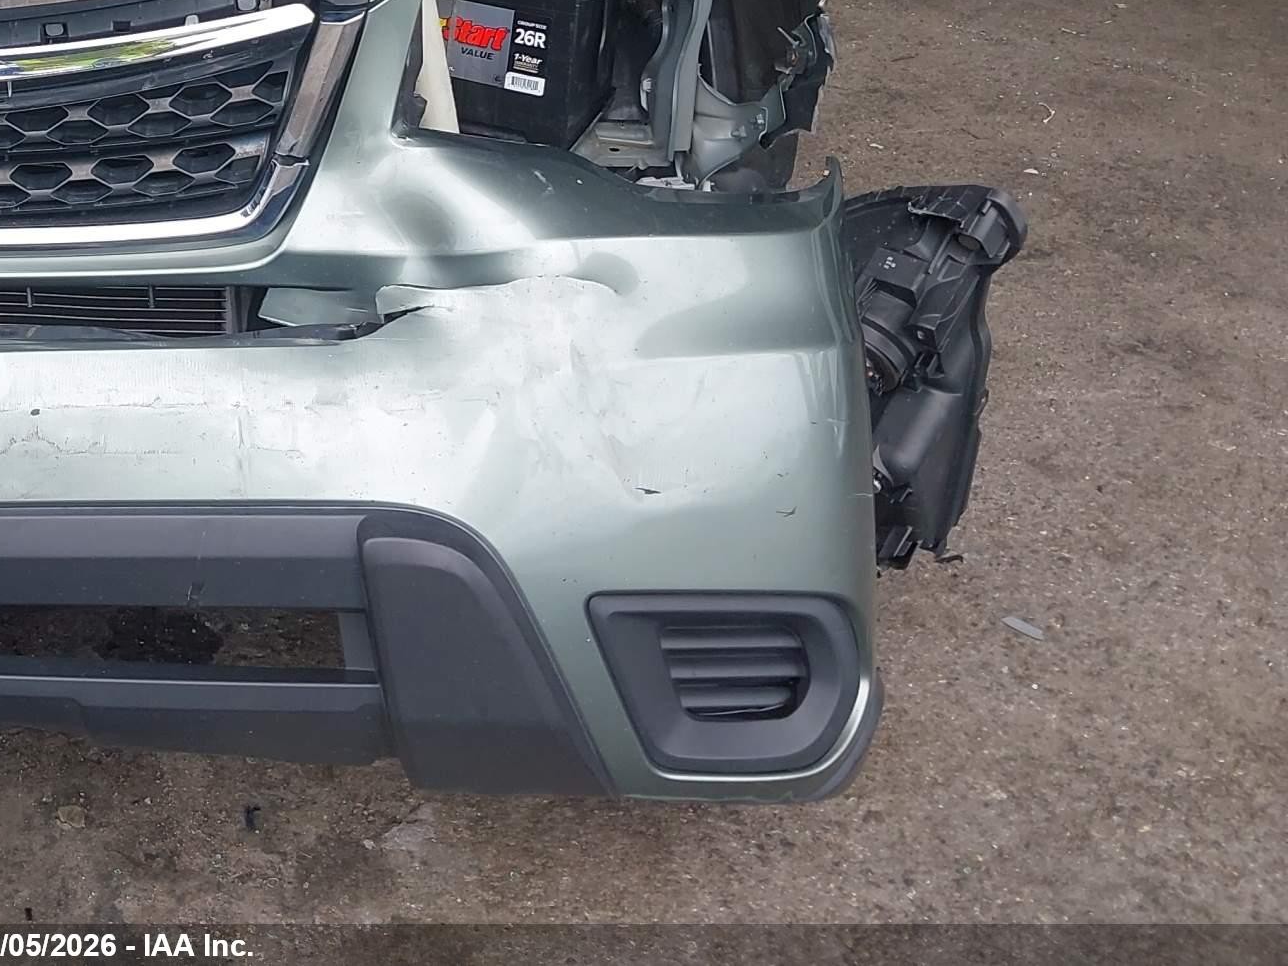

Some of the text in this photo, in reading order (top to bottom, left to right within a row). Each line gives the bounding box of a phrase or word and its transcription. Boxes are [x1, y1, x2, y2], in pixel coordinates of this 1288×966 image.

[514, 28, 546, 48] 26R
[460, 46, 495, 60] VALUE
[514, 53, 543, 65] 1-Year
